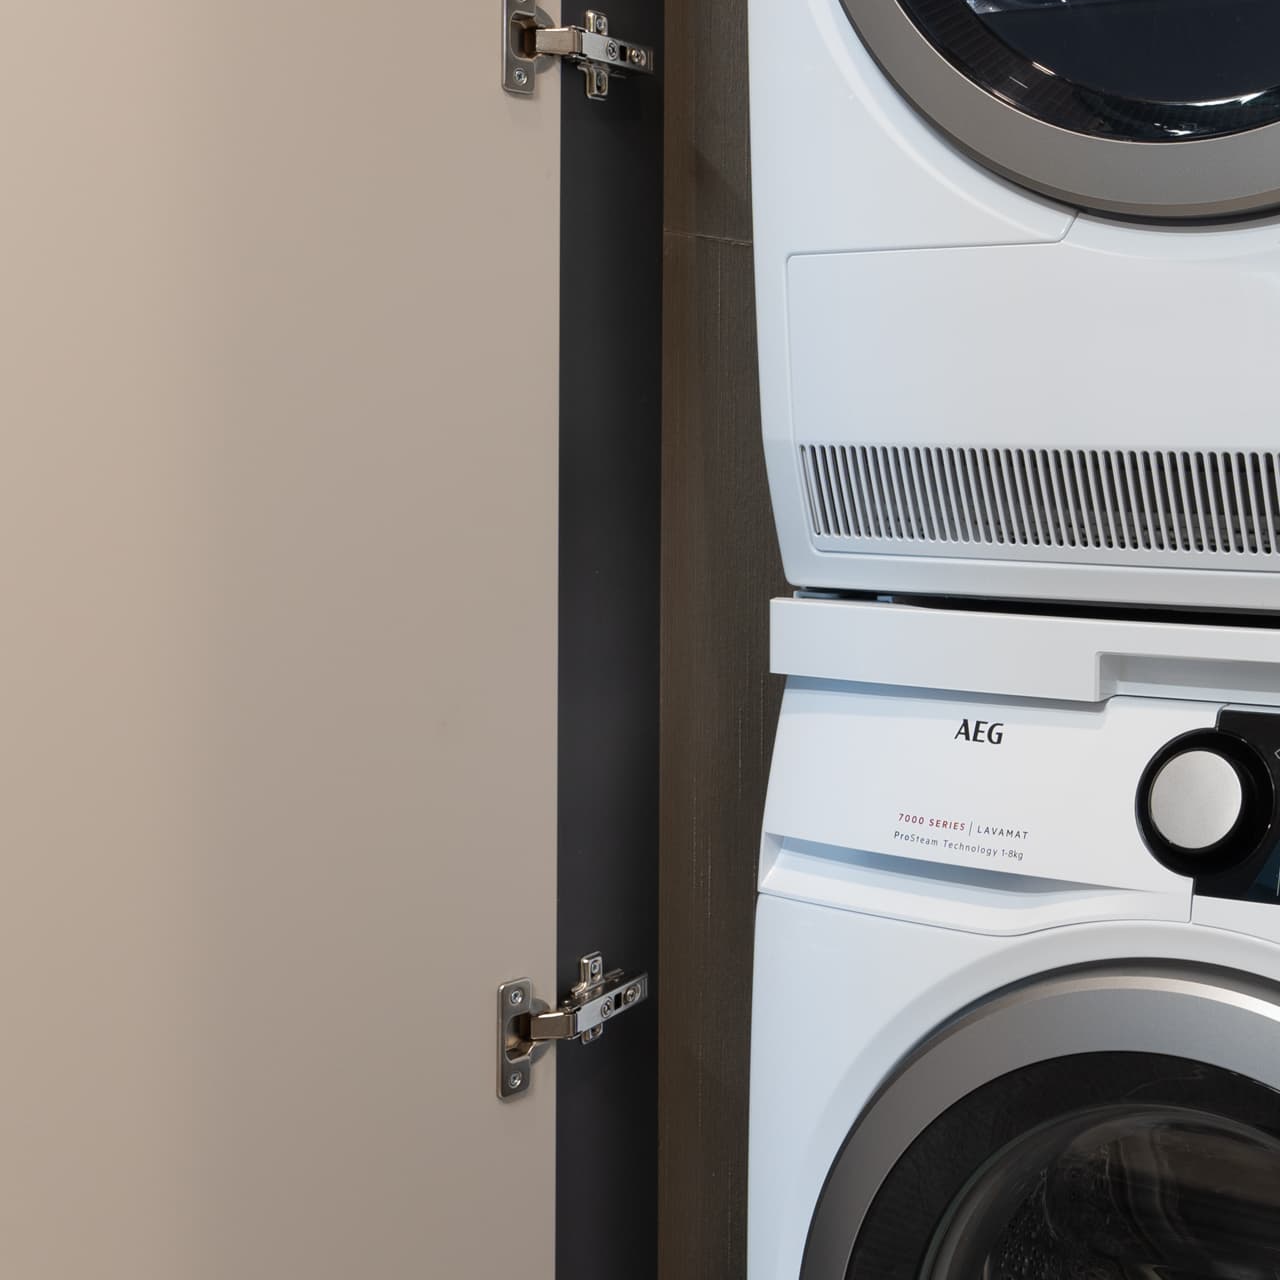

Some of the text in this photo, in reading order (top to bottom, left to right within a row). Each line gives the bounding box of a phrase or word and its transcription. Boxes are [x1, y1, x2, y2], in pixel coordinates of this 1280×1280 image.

[954, 718, 1005, 745] AEG
[898, 812, 1030, 840] 7000 SERIES LAVAMAT
[893, 830, 1025, 862] ProSteam Technology 1-8kg
